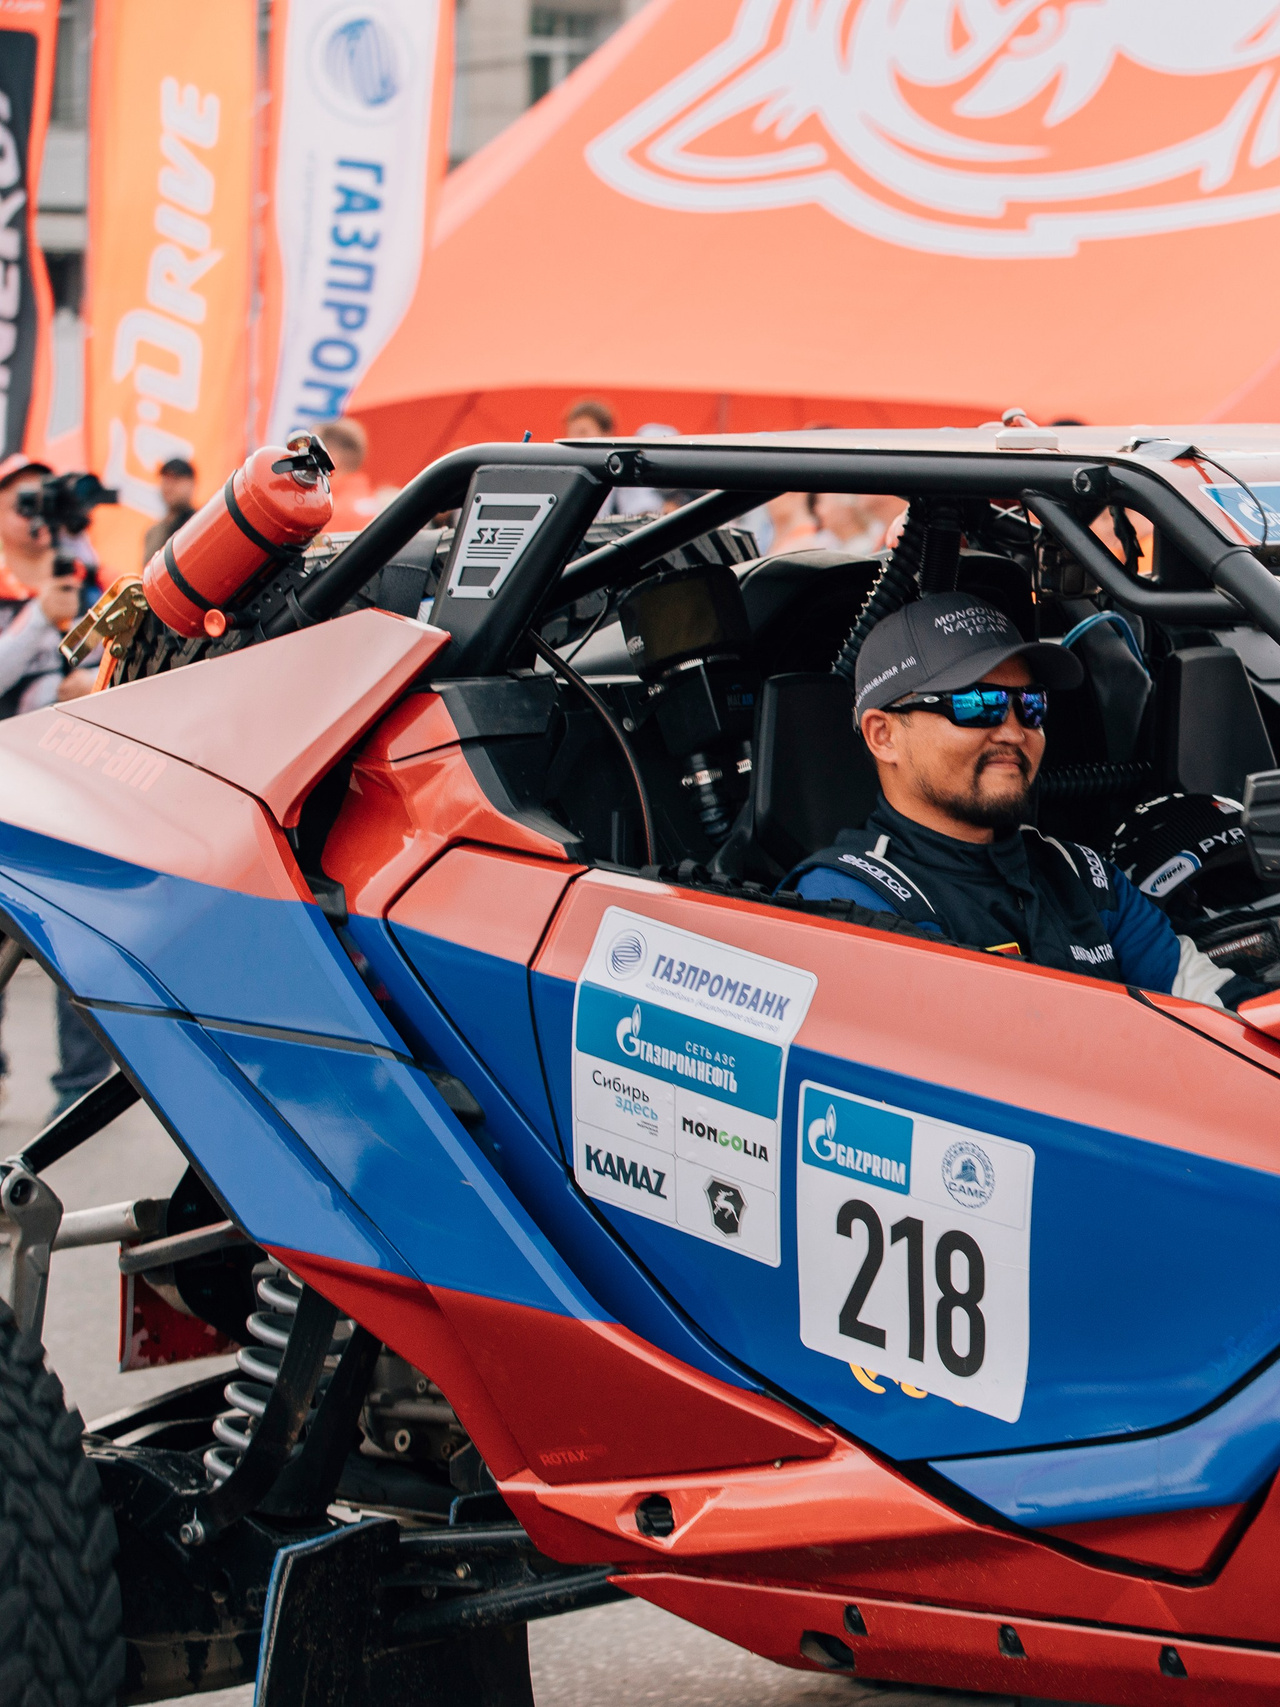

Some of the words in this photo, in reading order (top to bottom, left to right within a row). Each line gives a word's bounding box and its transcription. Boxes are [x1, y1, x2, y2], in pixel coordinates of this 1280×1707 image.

[290, 158, 383, 434] ГАЗПРОМ
[651, 954, 791, 1021] ГАЗПРОМБАНК
[685, 1041, 712, 1060] СЕТЬ
[713, 1051, 736, 1068] АЗС
[592, 1070, 650, 1103] Сибирь
[615, 1095, 659, 1121] здесь
[682, 1116, 770, 1163] MONGOLIA
[585, 1143, 668, 1200] KAMAZ
[836, 1143, 906, 1186] GAZPROM
[836, 1198, 986, 1378] 218
[540, 1449, 588, 1467] ROTAX
